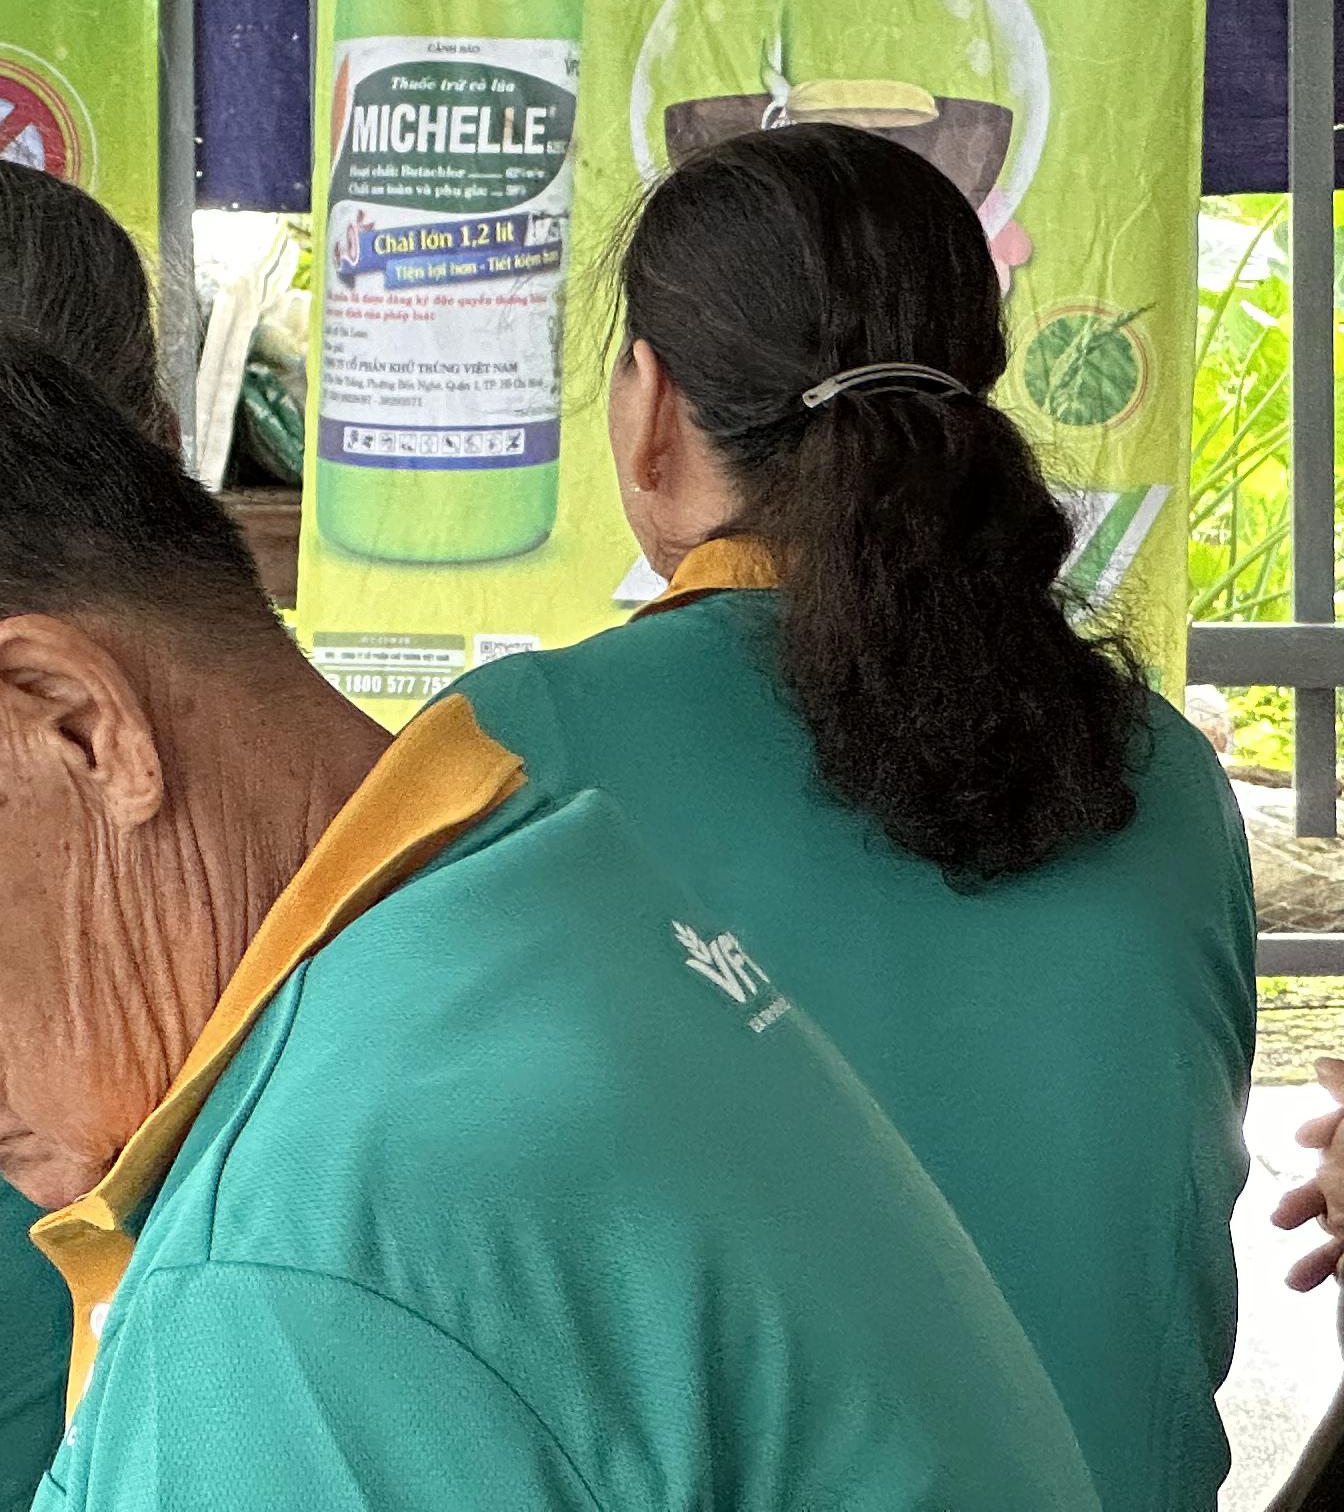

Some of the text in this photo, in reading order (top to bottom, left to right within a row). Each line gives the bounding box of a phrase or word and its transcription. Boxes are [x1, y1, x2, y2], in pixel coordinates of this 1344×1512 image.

[374, 229, 415, 255] Chai
[420, 227, 453, 251] lớn
[460, 223, 490, 248] 1,2
[387, 675, 417, 694] 577
[685, 931, 771, 1003] VF
